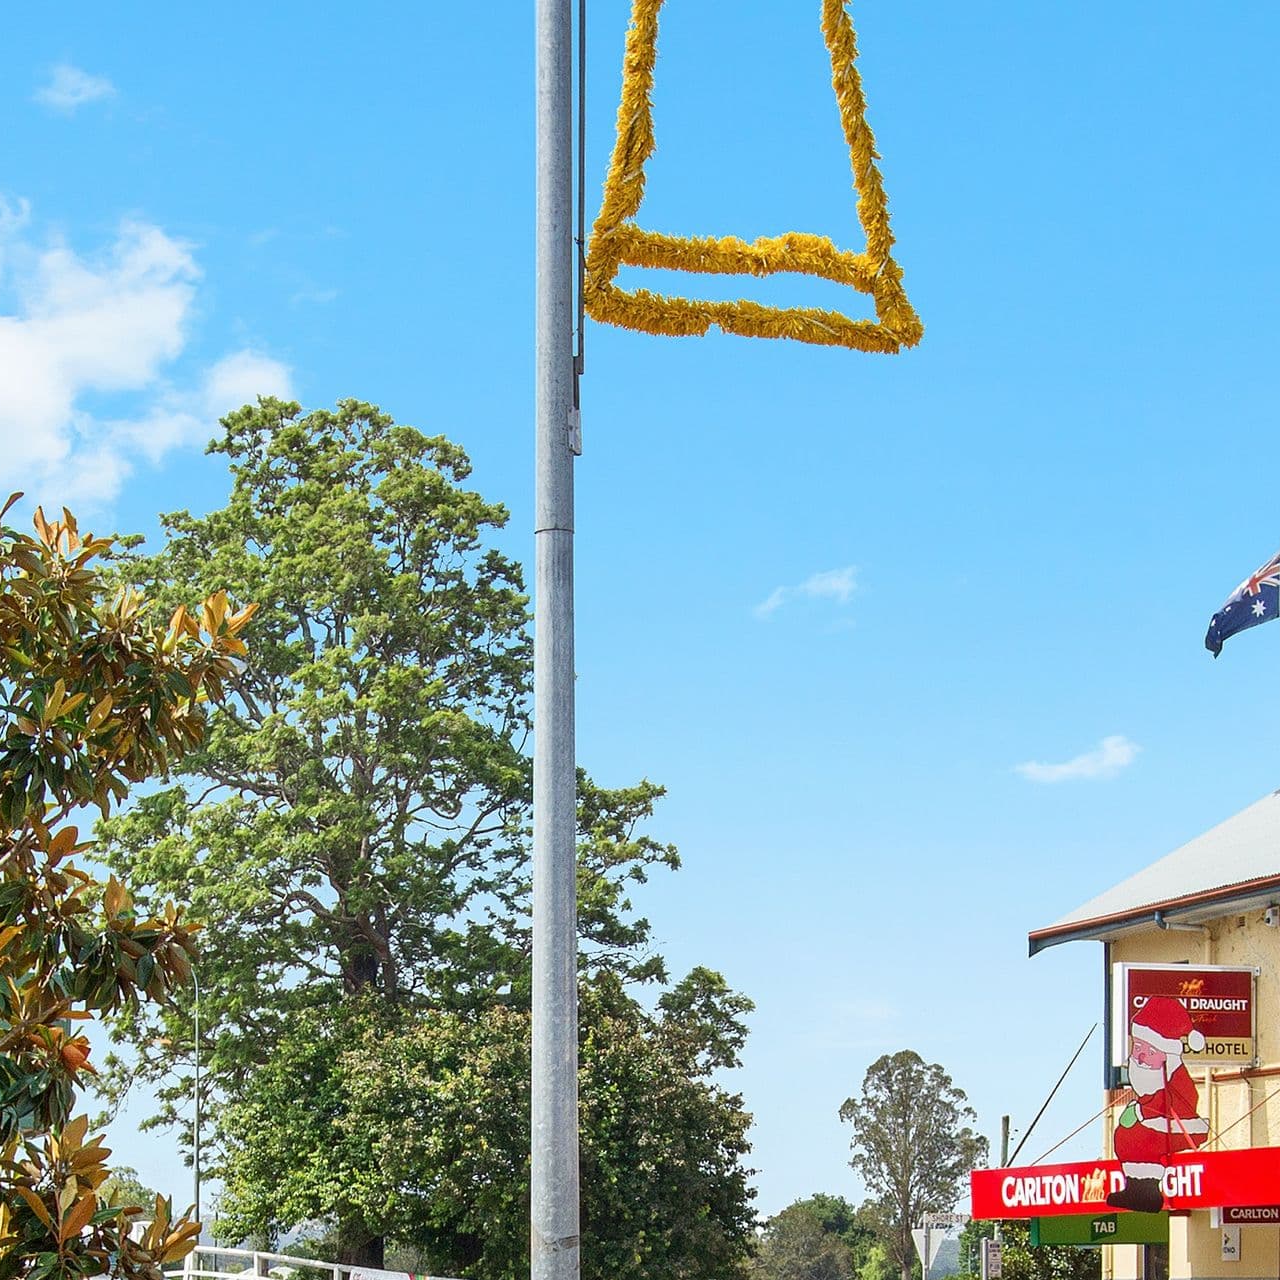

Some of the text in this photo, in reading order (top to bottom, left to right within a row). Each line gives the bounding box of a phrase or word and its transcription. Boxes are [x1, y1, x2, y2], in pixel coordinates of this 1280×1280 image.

[1190, 999, 1249, 1011] DRAUGHT
[1206, 1043, 1249, 1055] HOTEL
[1001, 1163, 1204, 1207] CARLTON DGHT
[1230, 1207, 1279, 1219] CARLTON
[1093, 1220, 1116, 1234] TAB
